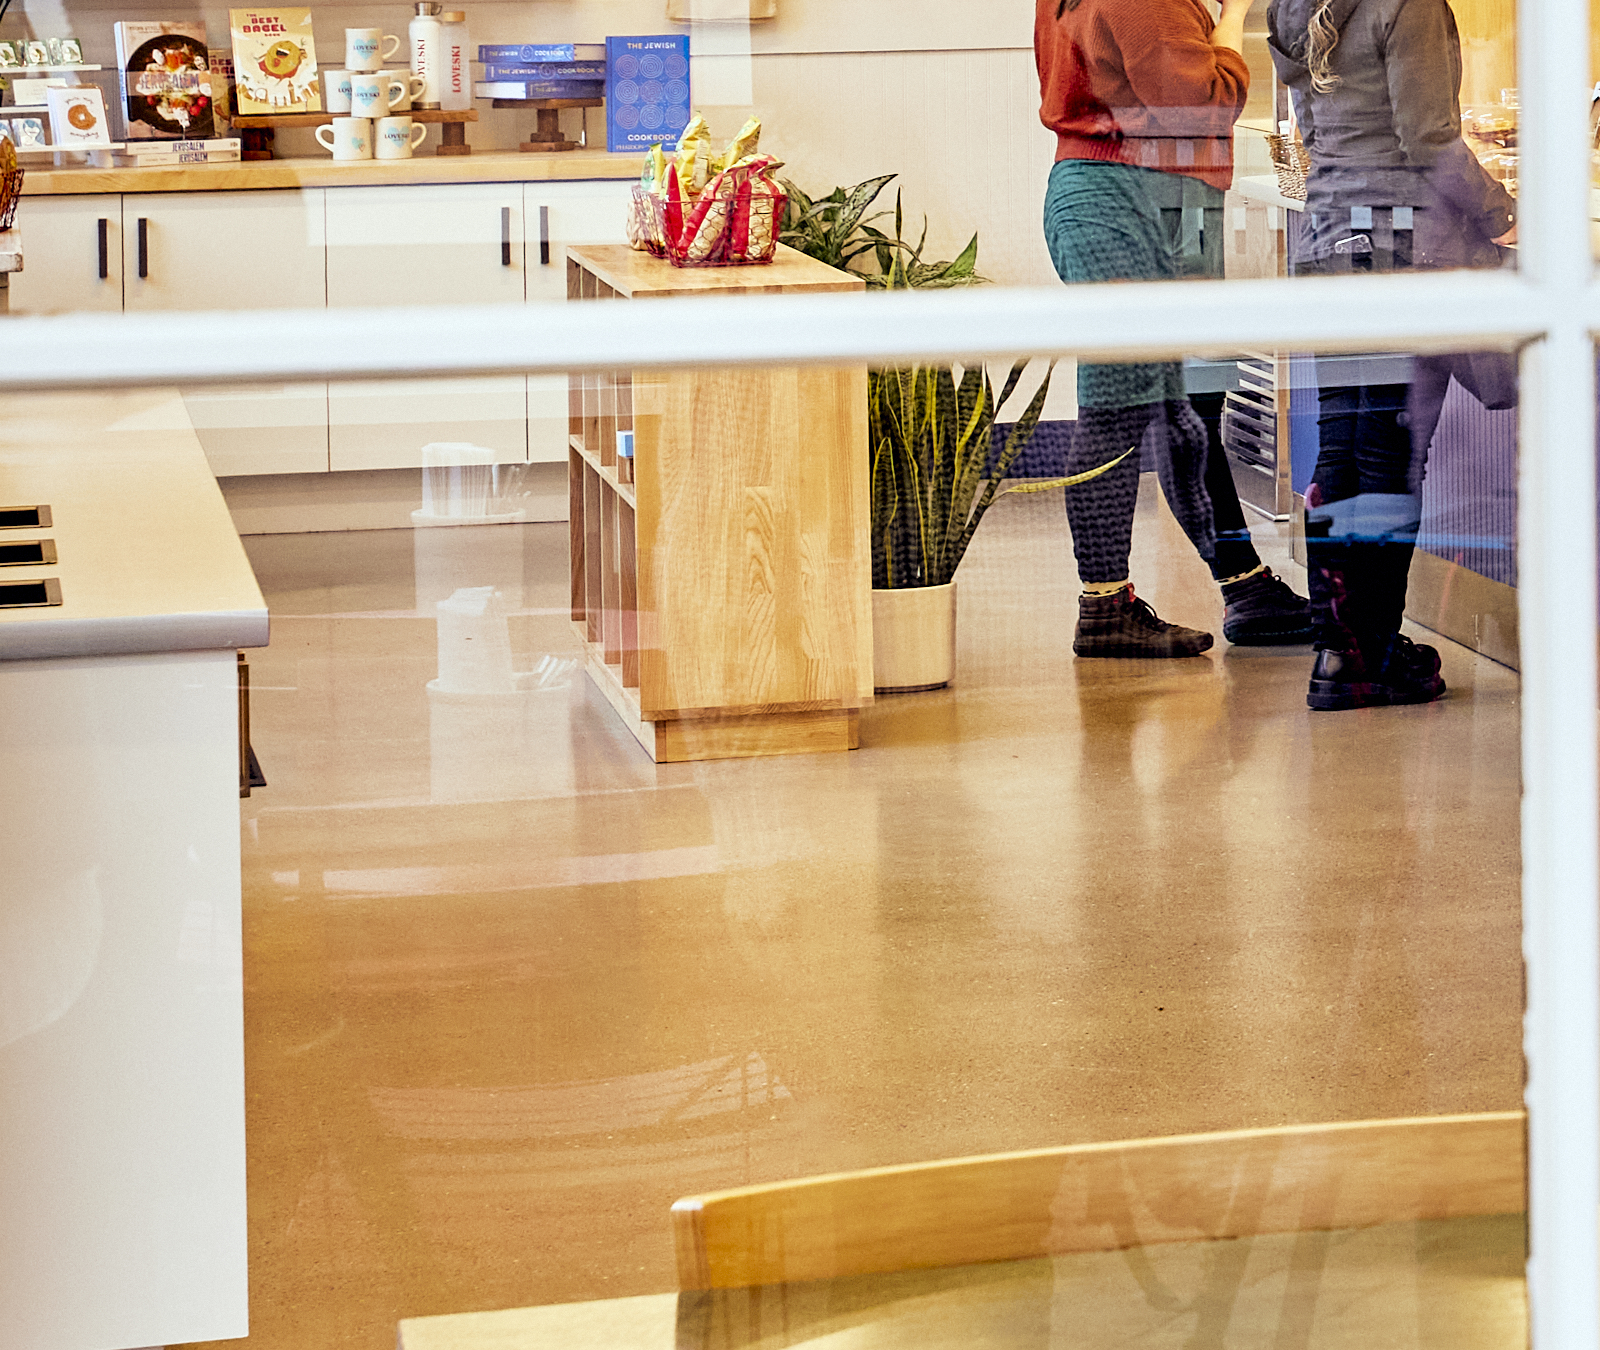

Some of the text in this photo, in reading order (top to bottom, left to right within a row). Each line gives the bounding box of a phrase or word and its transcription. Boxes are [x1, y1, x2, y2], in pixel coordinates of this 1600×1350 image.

[243, 25, 287, 33] BAGEL
[452, 46, 461, 93] LOVESKI
[140, 73, 199, 89] JERUSALEM
[173, 141, 204, 152] JERUSALEM
[179, 153, 208, 163] JERUSALEM
